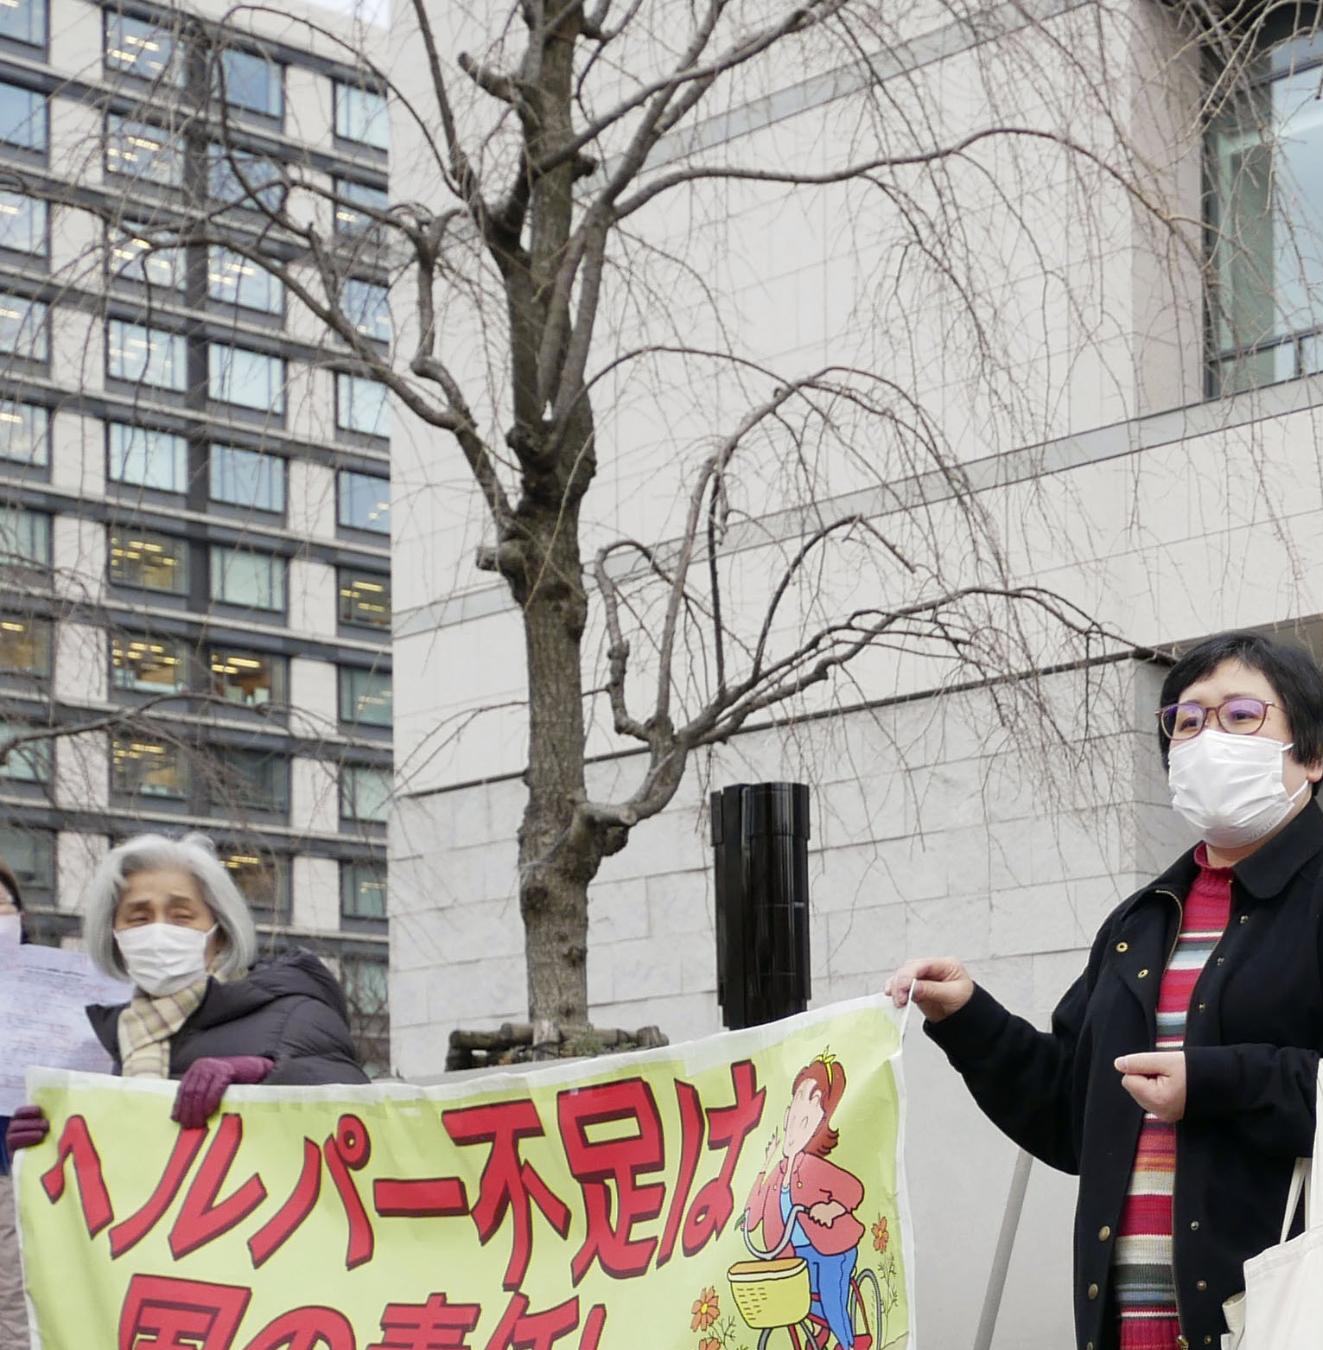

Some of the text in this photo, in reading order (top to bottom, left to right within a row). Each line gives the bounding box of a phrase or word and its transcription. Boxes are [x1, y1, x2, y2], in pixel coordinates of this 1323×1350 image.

[39, 1058, 767, 1292] ヘルパー不足は
